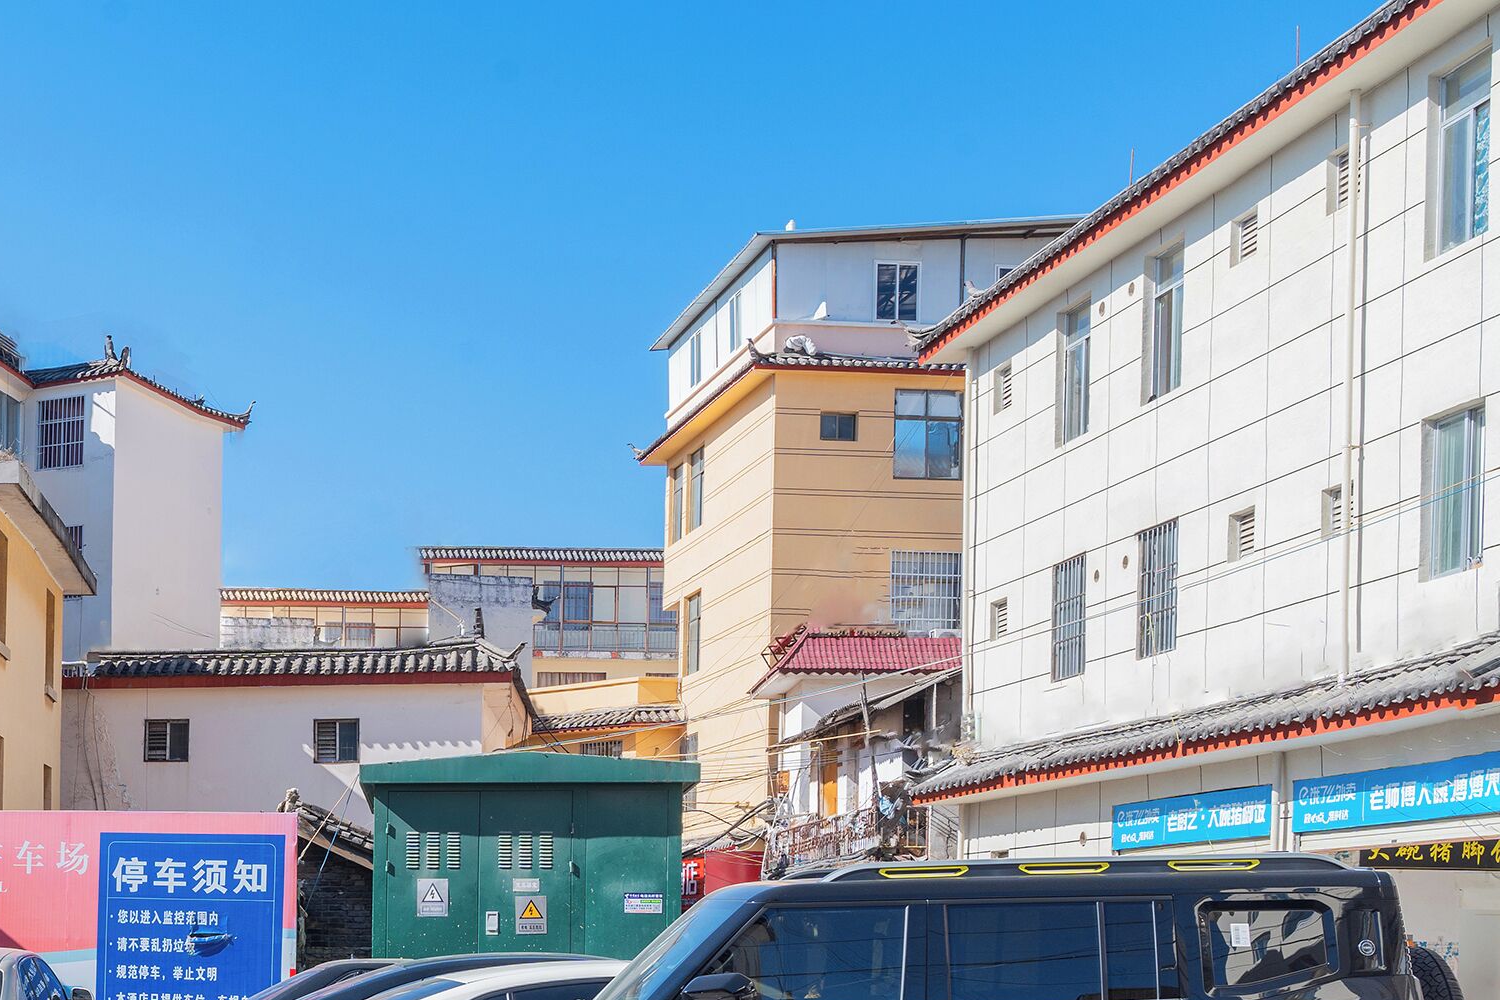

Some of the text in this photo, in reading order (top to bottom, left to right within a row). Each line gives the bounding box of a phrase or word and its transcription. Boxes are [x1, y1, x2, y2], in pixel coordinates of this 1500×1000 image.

[112, 857, 267, 895] 停车须知
[117, 910, 219, 926] 您以进入监控范围内
